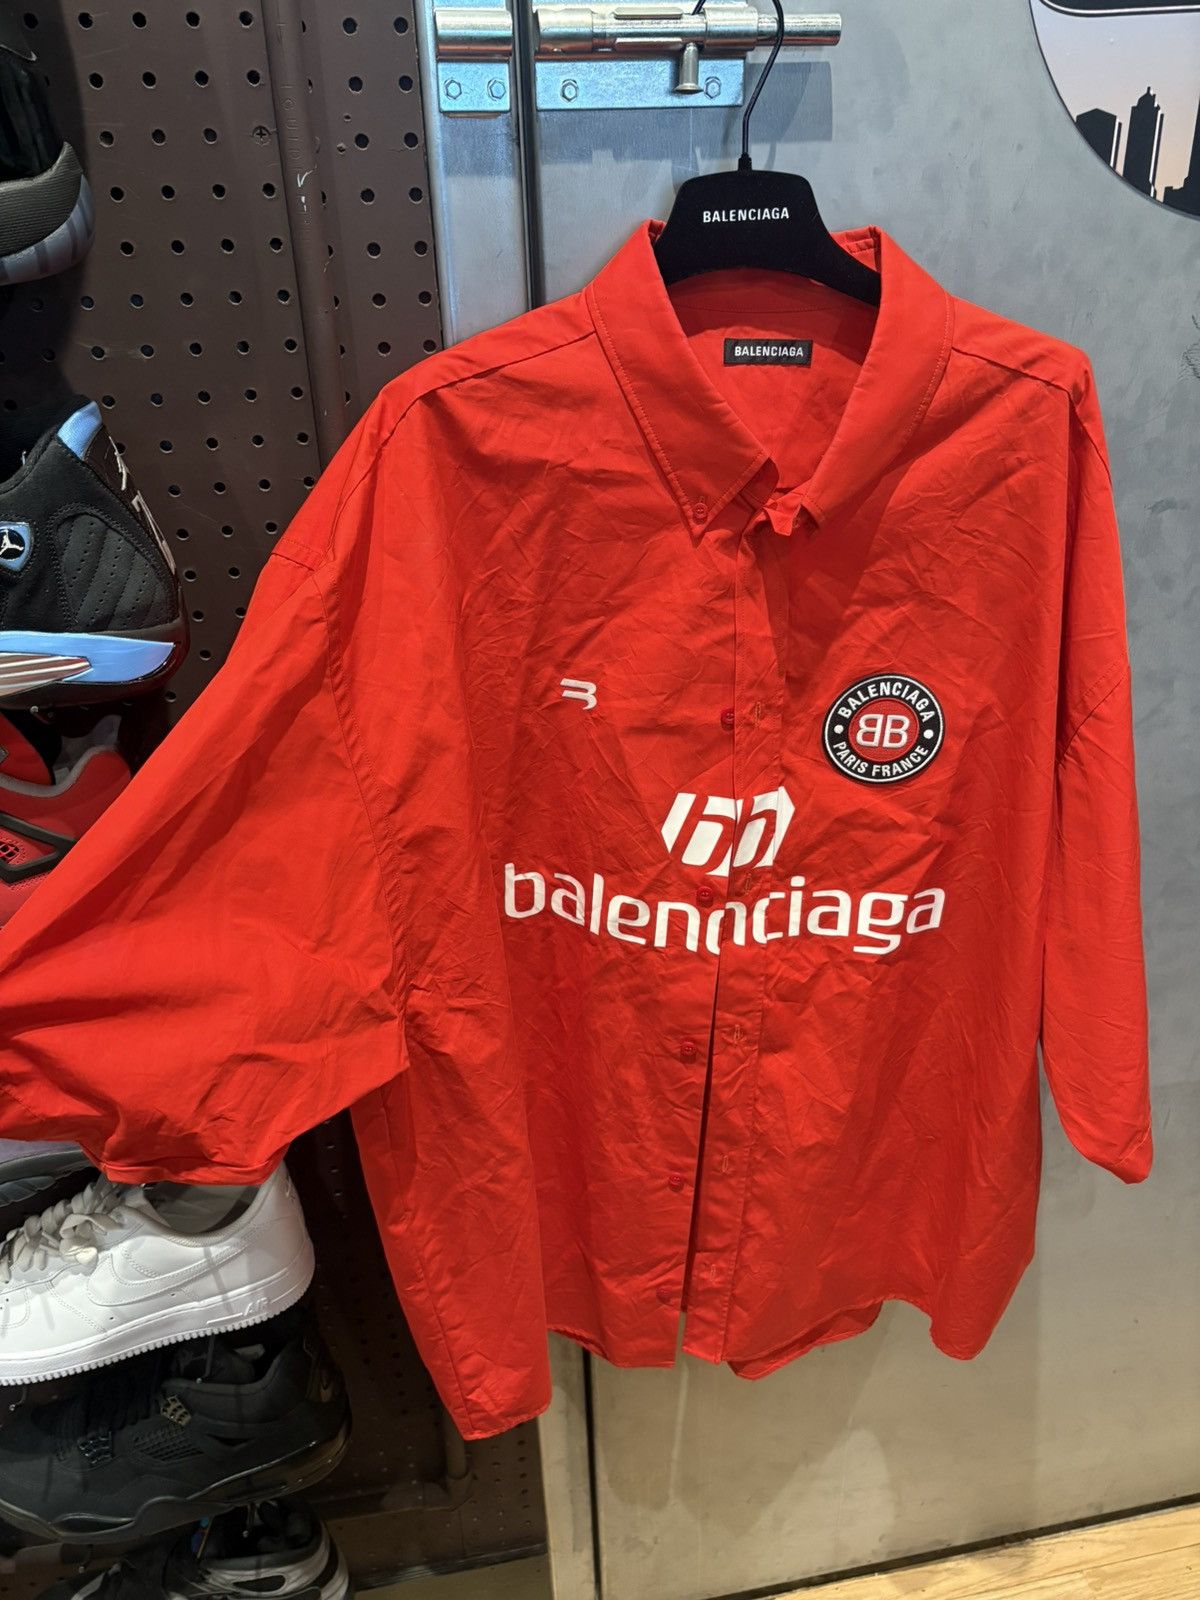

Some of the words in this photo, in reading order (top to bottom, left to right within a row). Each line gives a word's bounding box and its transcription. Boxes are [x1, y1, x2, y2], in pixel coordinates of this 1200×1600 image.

[702, 206, 790, 223] BALENCIAGA
[733, 345, 804, 357] BALENCIAGA
[837, 681, 936, 723] BALENCIAGA
[832, 741, 869, 774] PARIS
[871, 745, 929, 777] FRANCE
